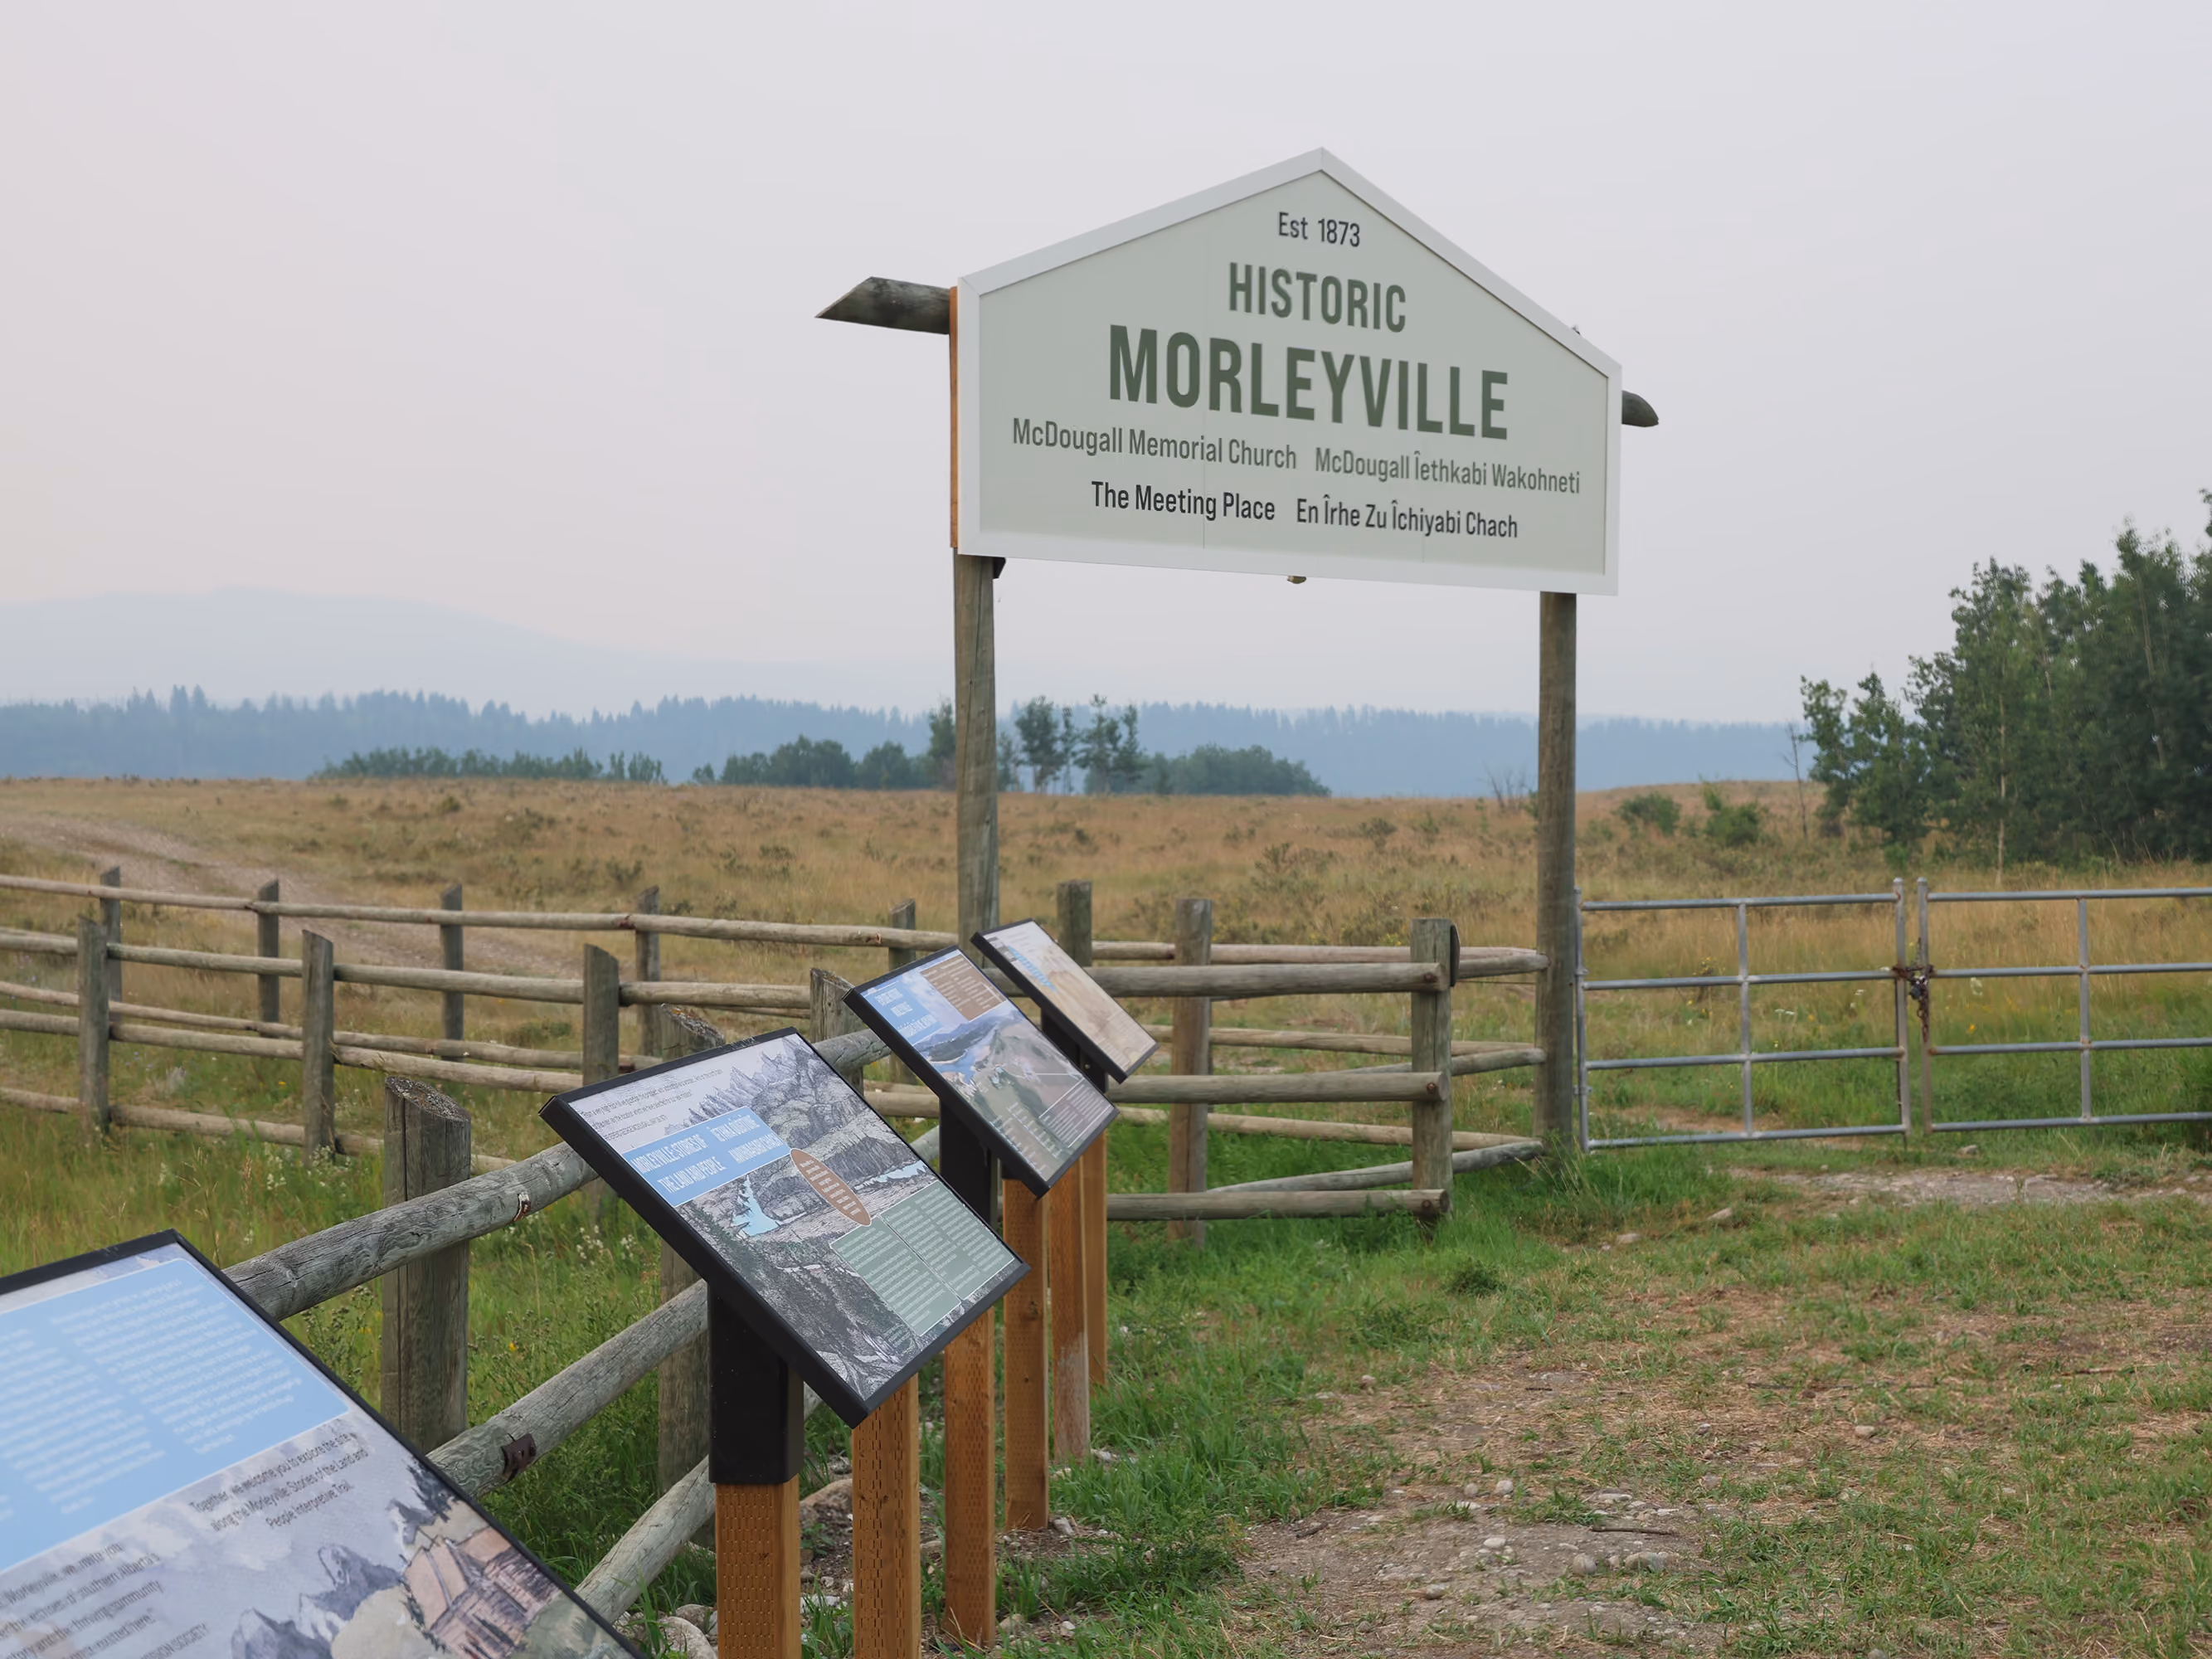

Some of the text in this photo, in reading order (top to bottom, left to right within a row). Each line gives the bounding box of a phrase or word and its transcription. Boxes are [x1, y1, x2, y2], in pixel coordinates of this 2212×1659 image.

[1278, 211, 1361, 248] Est 1873
[1228, 261, 1407, 333] HISTORIC
[1109, 324, 1509, 441] MORLEYVILLE
[1013, 417, 1581, 495] McDougall Memorial Church McDougall Îethkabi Wakohneti
[1091, 480, 1519, 538] The Meeting Place En Îrhe Zu Îchiyabi Chach
[656, 1156, 727, 1194] THE LAND AND PEOPLE
[241, 1467, 277, 1491] welcome
[275, 1464, 291, 1478] you
[297, 1447, 326, 1465] explore
[286, 1474, 318, 1494] Stories
[332, 1451, 357, 1471] Land
[265, 1508, 298, 1529] People
[290, 1489, 338, 1515] Interpretive
